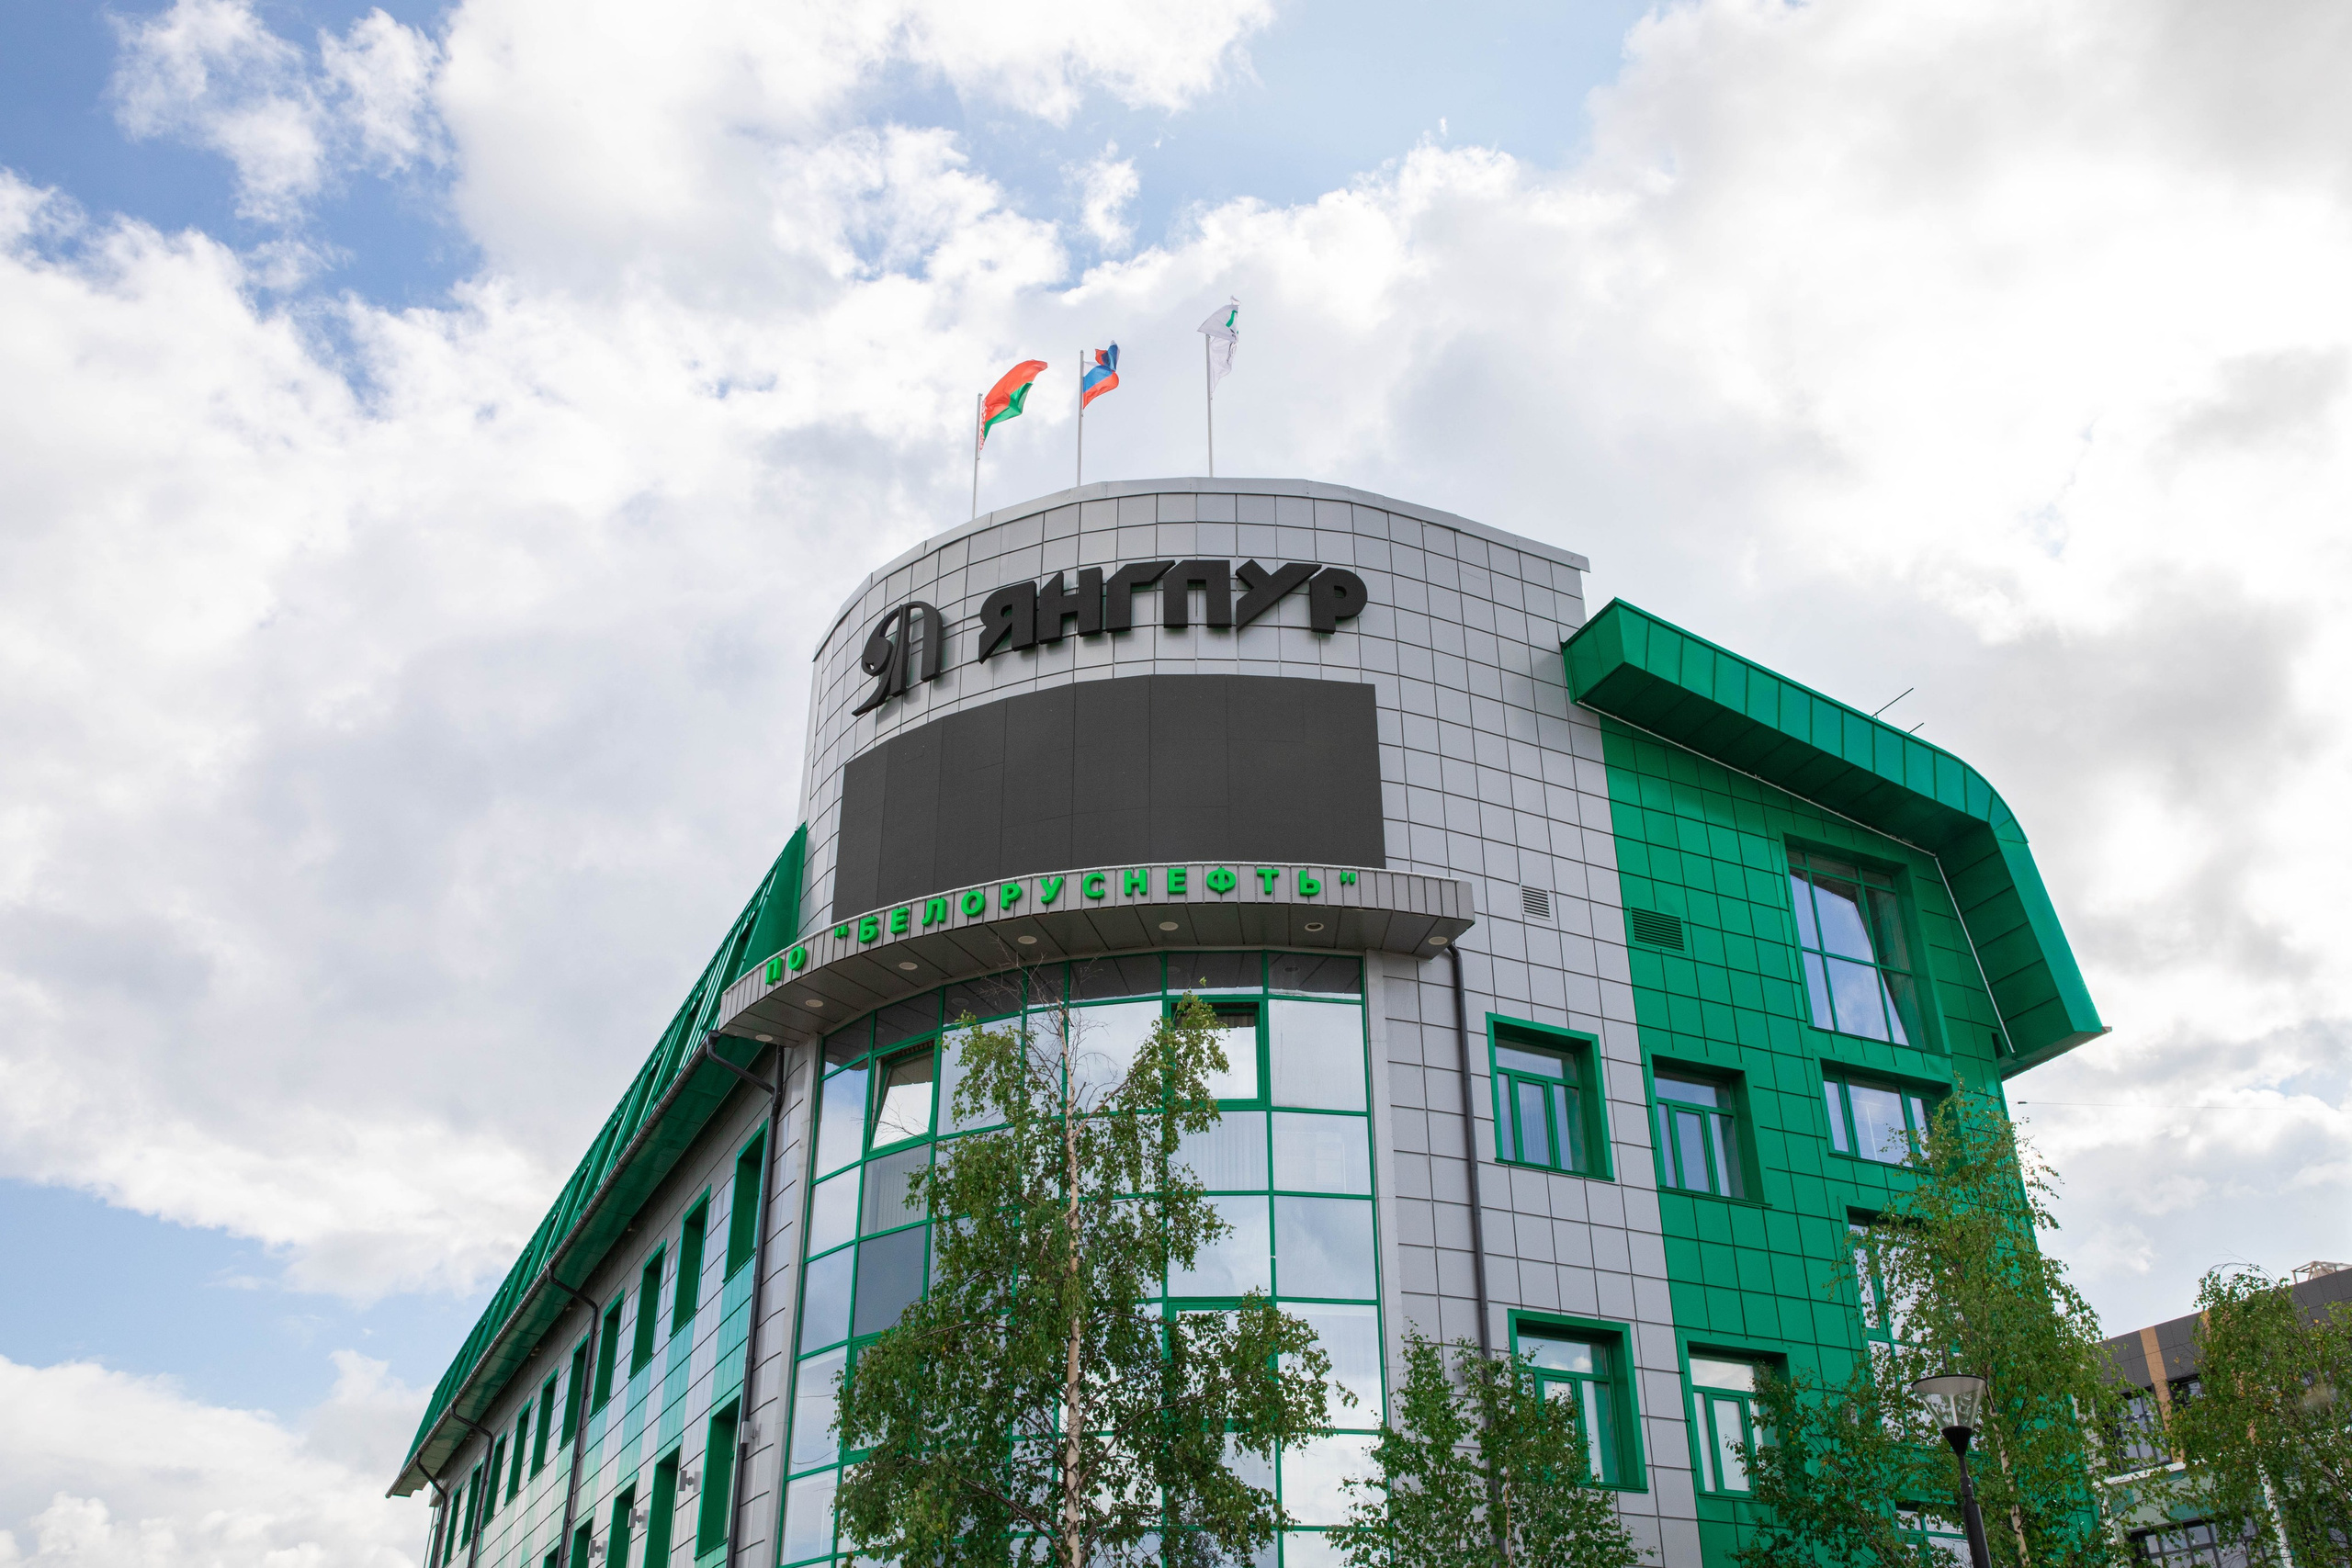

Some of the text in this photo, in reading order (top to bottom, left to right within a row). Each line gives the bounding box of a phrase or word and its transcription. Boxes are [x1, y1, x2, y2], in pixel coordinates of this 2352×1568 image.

[978, 558, 1369, 664] ЯНГПУР
[764, 867, 1357, 986] ПО "БЕЛОРУСНЕФТЬ"
